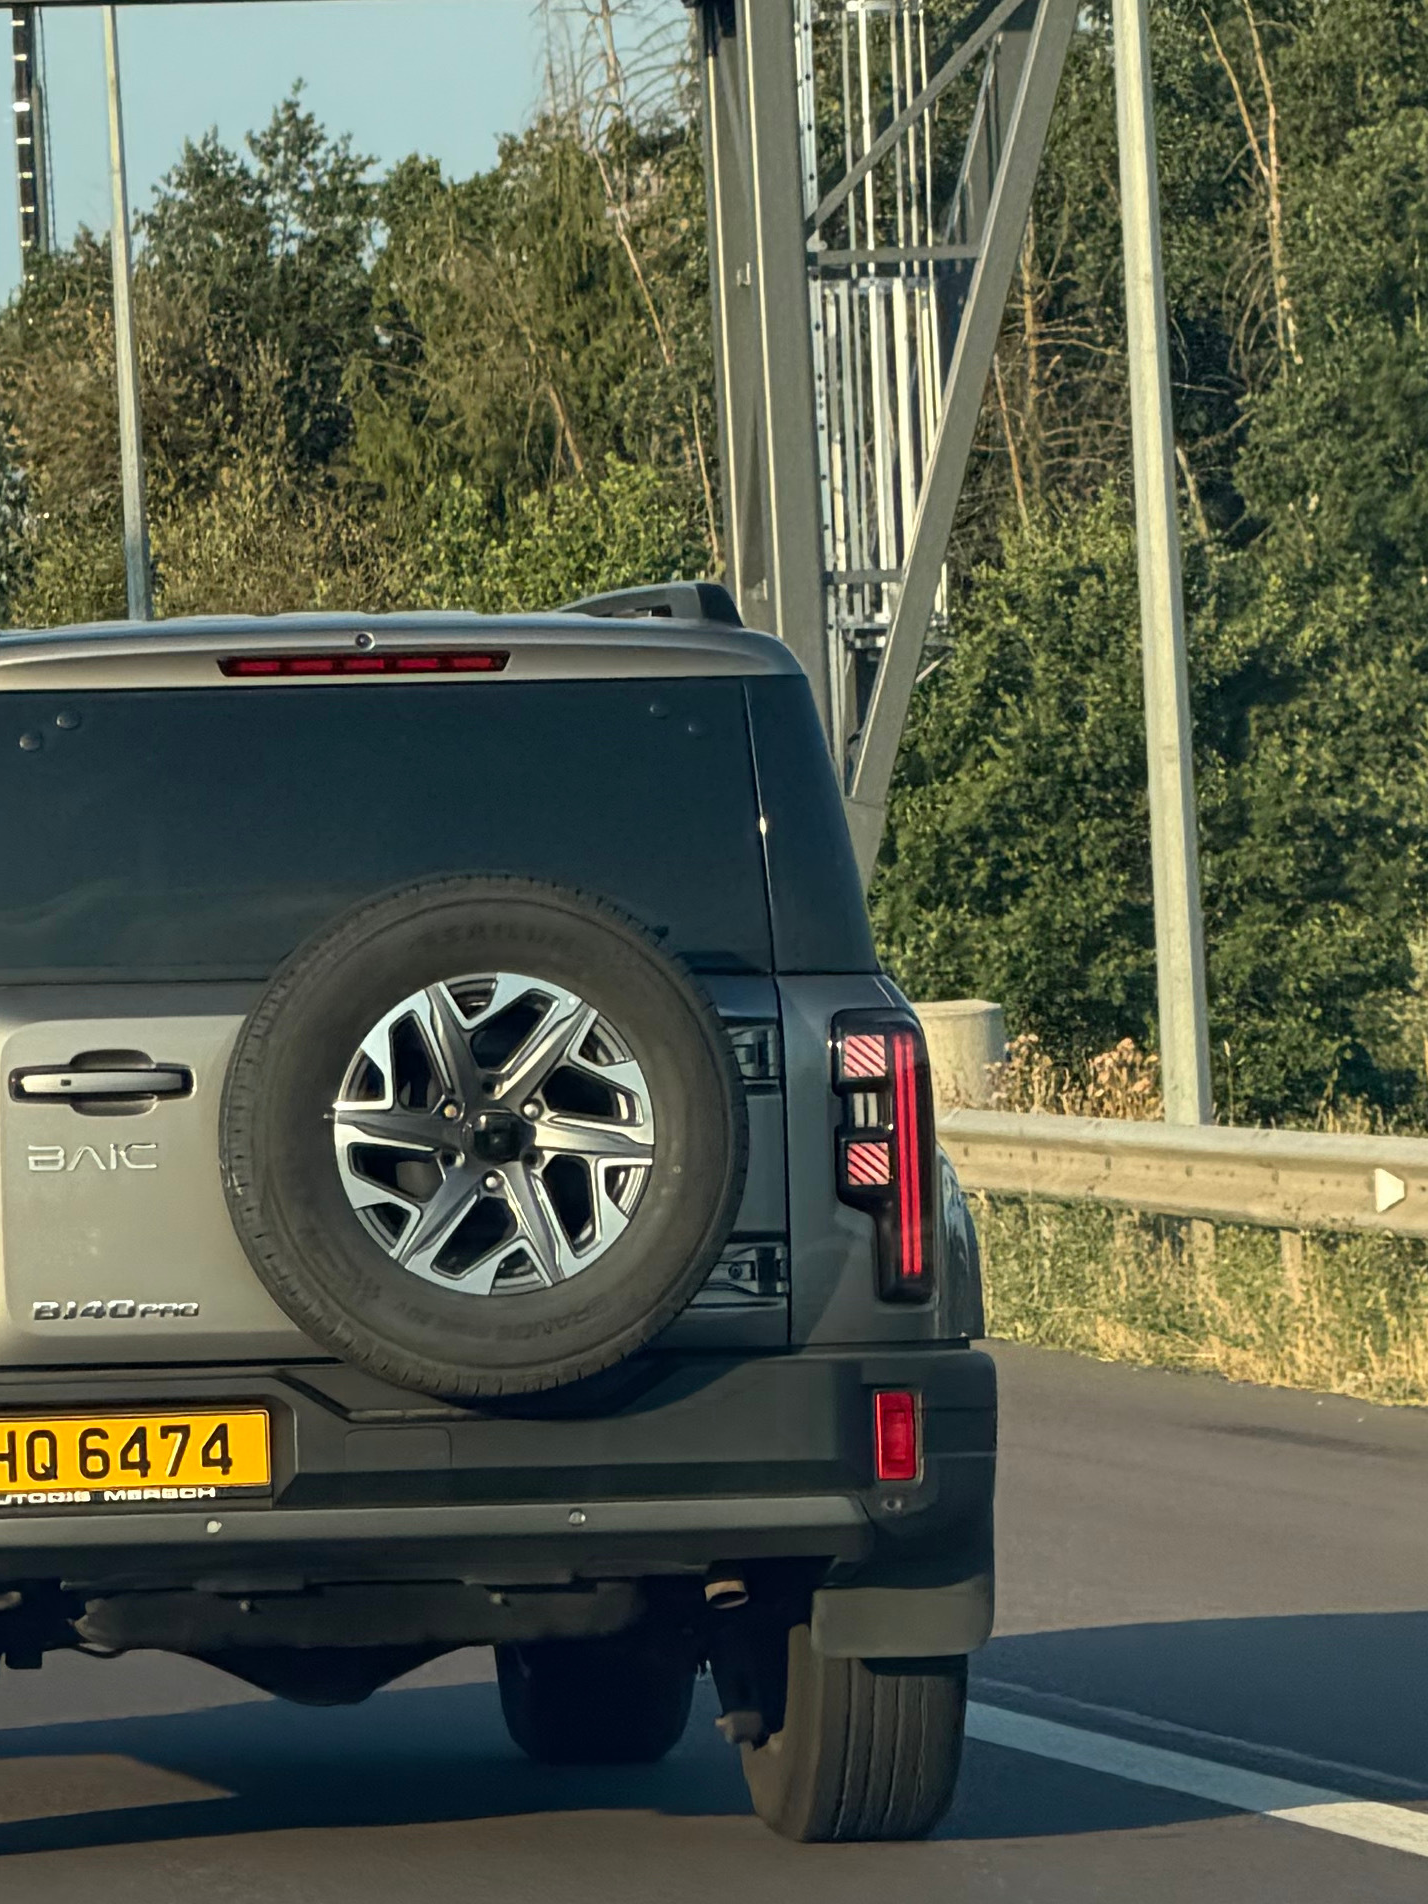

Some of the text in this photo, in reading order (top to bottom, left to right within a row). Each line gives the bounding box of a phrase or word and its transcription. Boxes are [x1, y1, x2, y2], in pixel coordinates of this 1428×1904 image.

[27, 1143, 158, 1172] BAIC
[138, 1302, 200, 1318] PRO
[77, 1423, 233, 1480] 6474
